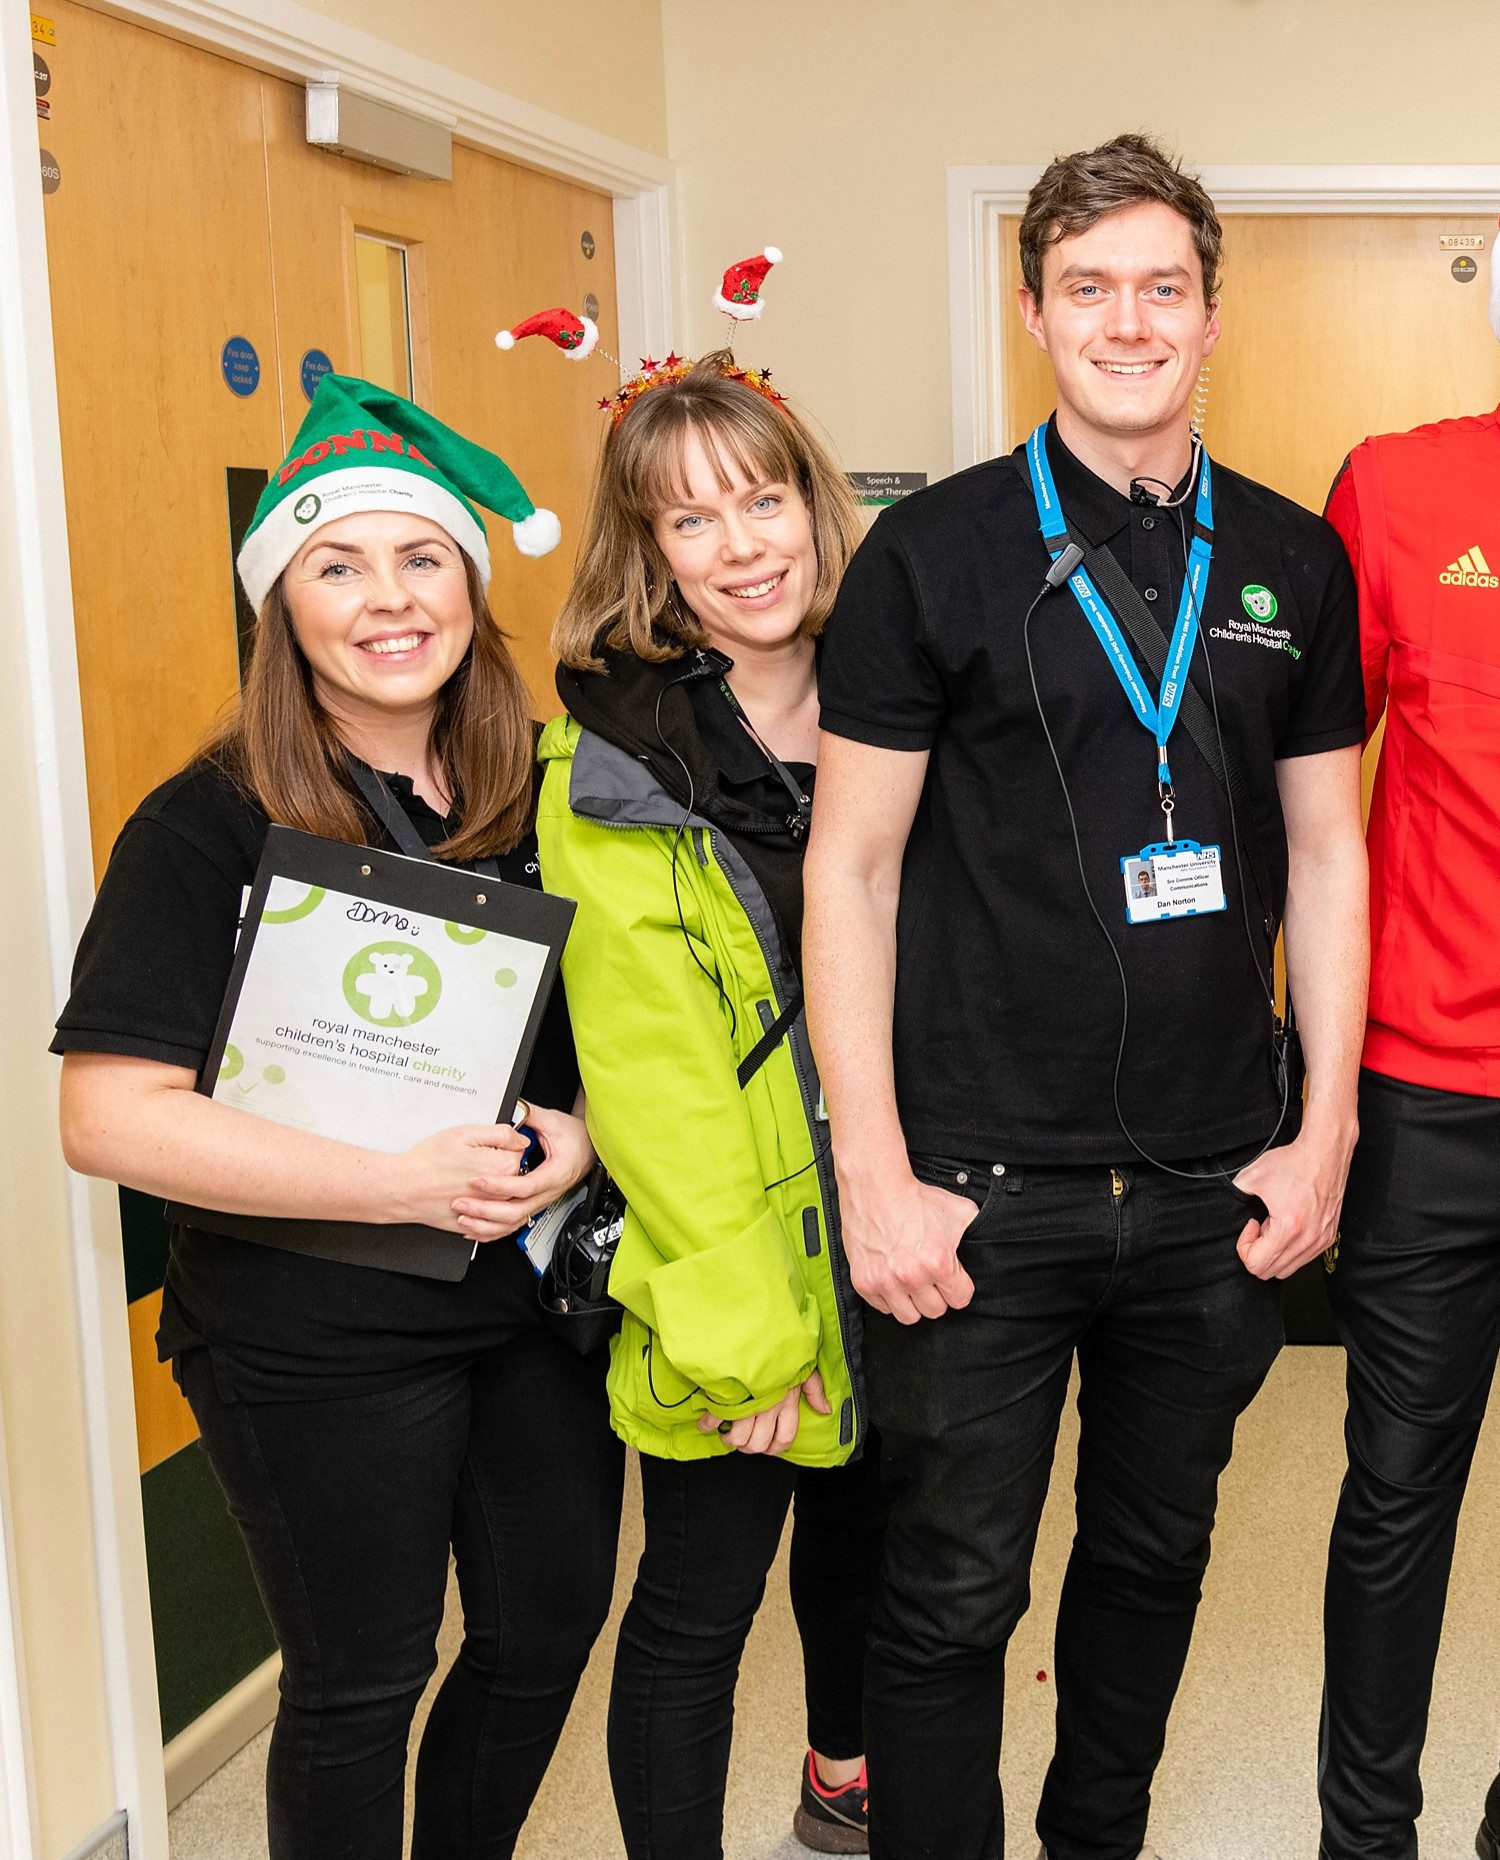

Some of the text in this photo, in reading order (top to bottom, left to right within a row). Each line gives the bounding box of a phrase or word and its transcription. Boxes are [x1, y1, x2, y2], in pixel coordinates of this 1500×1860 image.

[866, 476, 900, 485] Speech &
[1073, 576, 1091, 598] NHS
[1439, 570, 1499, 588] adidas
[1228, 619, 1250, 632] Royal
[1176, 632, 1187, 665] Foundation
[1209, 628, 1252, 643] Children's
[1252, 634, 1282, 650] Hospital
[1088, 598, 1147, 714] Manchester University NHS Foundation Trust
[1172, 664, 1180, 680] Trust
[1163, 682, 1176, 707] NHS
[1190, 860, 1216, 868] University
[1196, 851, 1216, 860] NHS
[1170, 882, 1208, 891] Communications
[1172, 897, 1196, 906] Norton
[312, 1018, 440, 1056] royal manchester
[256, 1037, 300, 1054] supporting
[302, 1050, 346, 1066] excellence
[359, 1064, 400, 1079] treatment,
[404, 1074, 422, 1083] care
[424, 1078, 440, 1088] and
[442, 1082, 478, 1096] research
[350, 1043, 410, 1067] hospital
[412, 1060, 467, 1082] charity
